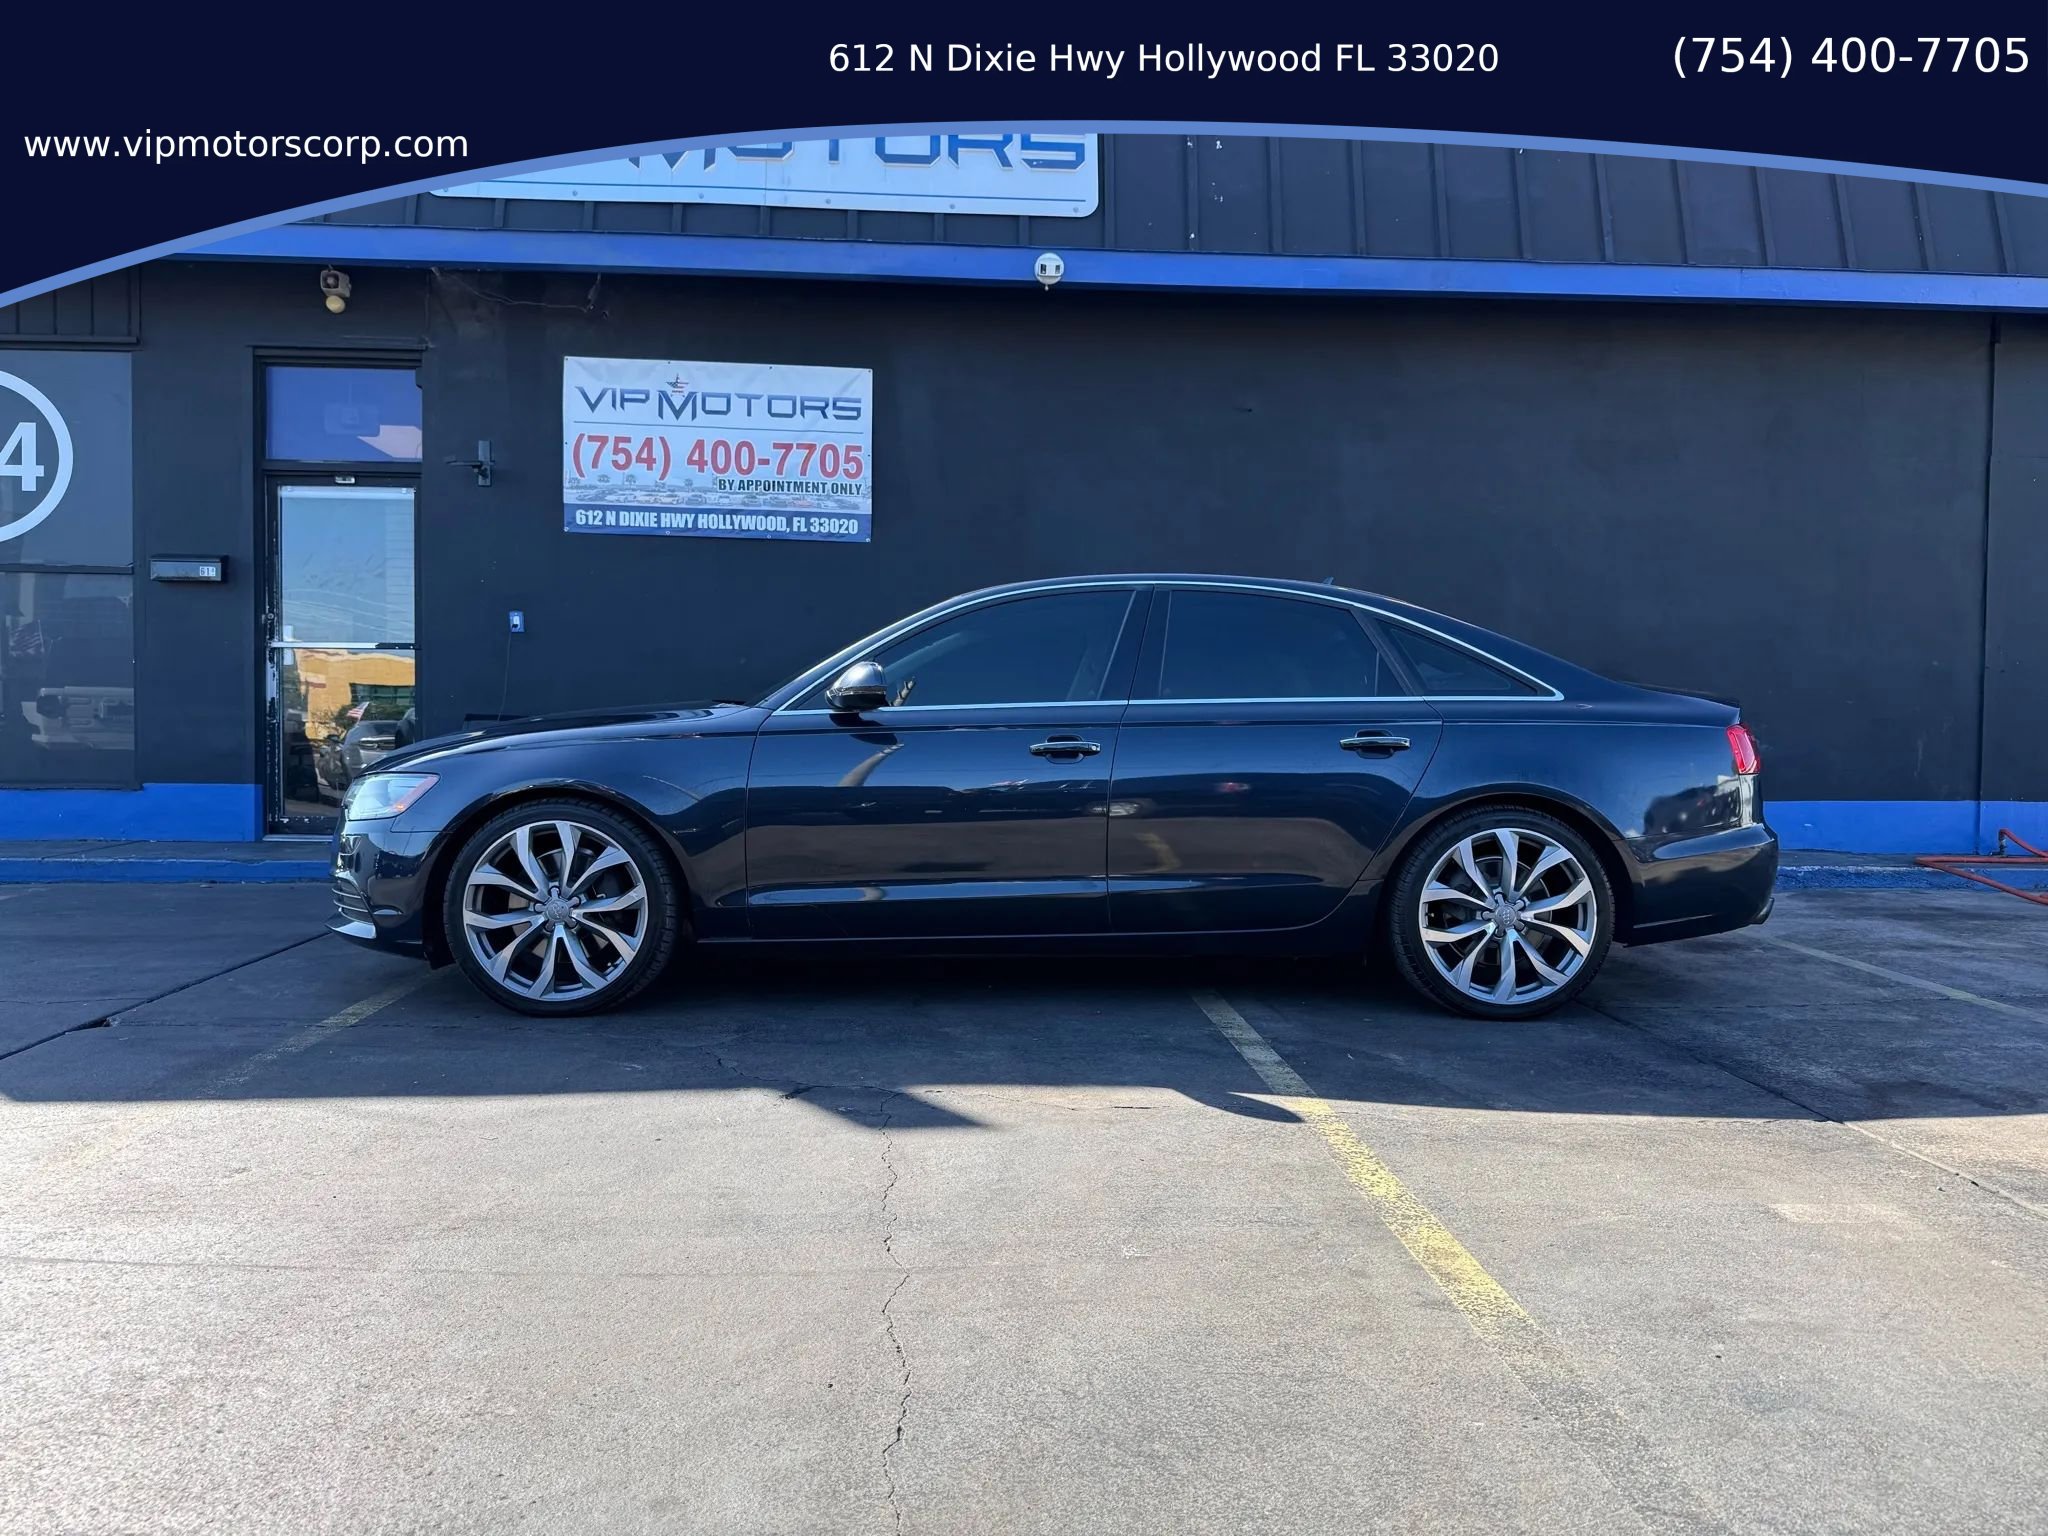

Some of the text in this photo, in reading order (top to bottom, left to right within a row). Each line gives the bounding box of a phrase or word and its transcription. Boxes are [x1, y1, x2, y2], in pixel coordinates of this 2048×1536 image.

[574, 386, 862, 421] VIP MOTORS
[573, 433, 863, 481] (754) 400-7705
[718, 478, 863, 496] BY APPOINTMENT ONLY
[575, 509, 859, 534] 612 N DIXIE HWY HOLLYWOOD, FL 33020
